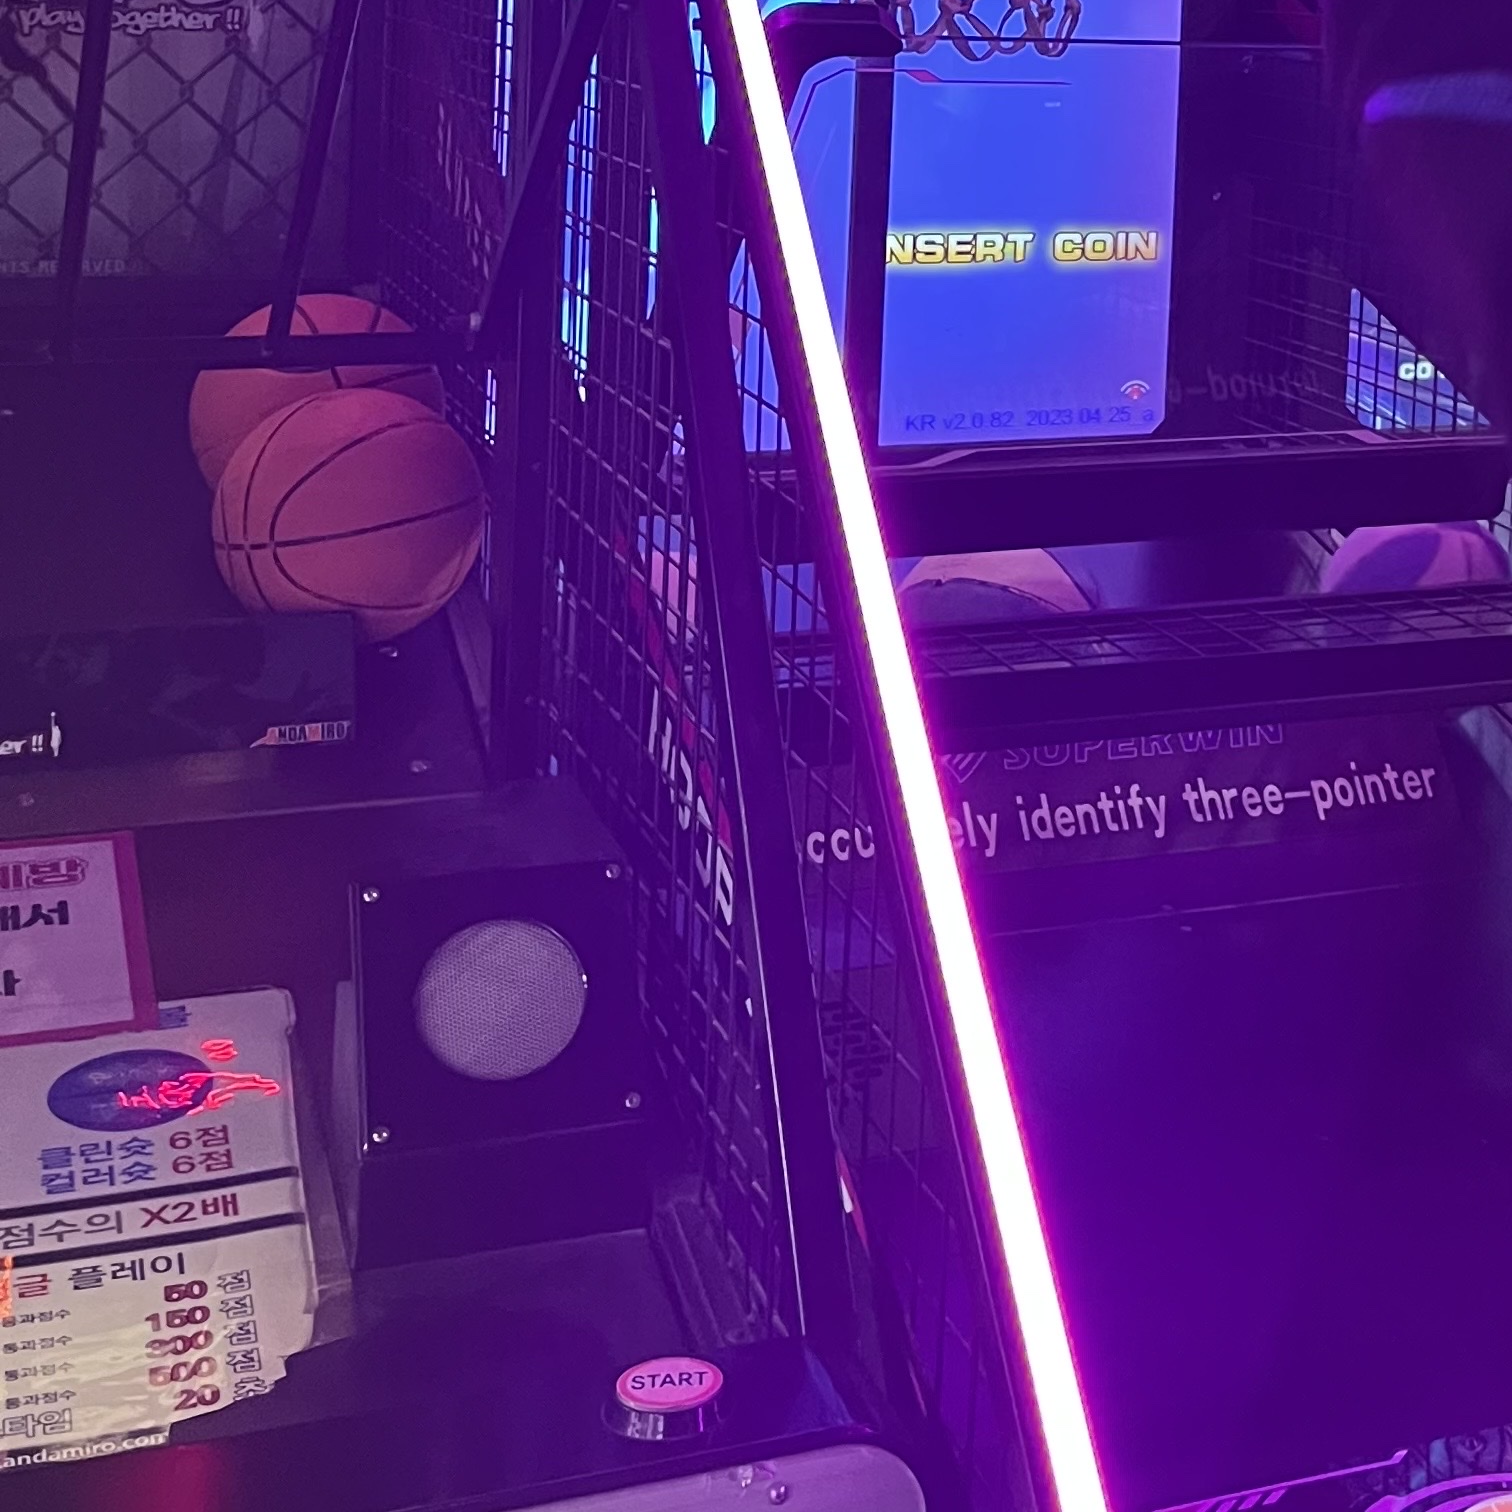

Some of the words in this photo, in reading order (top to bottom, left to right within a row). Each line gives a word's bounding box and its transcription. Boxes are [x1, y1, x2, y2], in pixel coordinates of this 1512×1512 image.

[19, 3, 85, 34] play
[110, 4, 221, 35] ogether
[885, 232, 1036, 265] NSERT
[1052, 231, 1159, 262] COIN
[905, 413, 936, 432] KR
[1018, 782, 1168, 838] identify
[1182, 761, 1437, 821] three-pointer
[168, 1123, 231, 1151] 6점
[171, 1148, 235, 1175] 6점
[68, 1251, 186, 1291] 플레이
[163, 1279, 208, 1303] 50
[216, 1269, 251, 1294] 점
[144, 1305, 211, 1332] 150
[219, 1294, 255, 1320] 점
[225, 1347, 262, 1374] 점
[630, 1370, 709, 1391] START
[173, 1383, 221, 1412] 20
[0, 1407, 73, 1439] 타임
